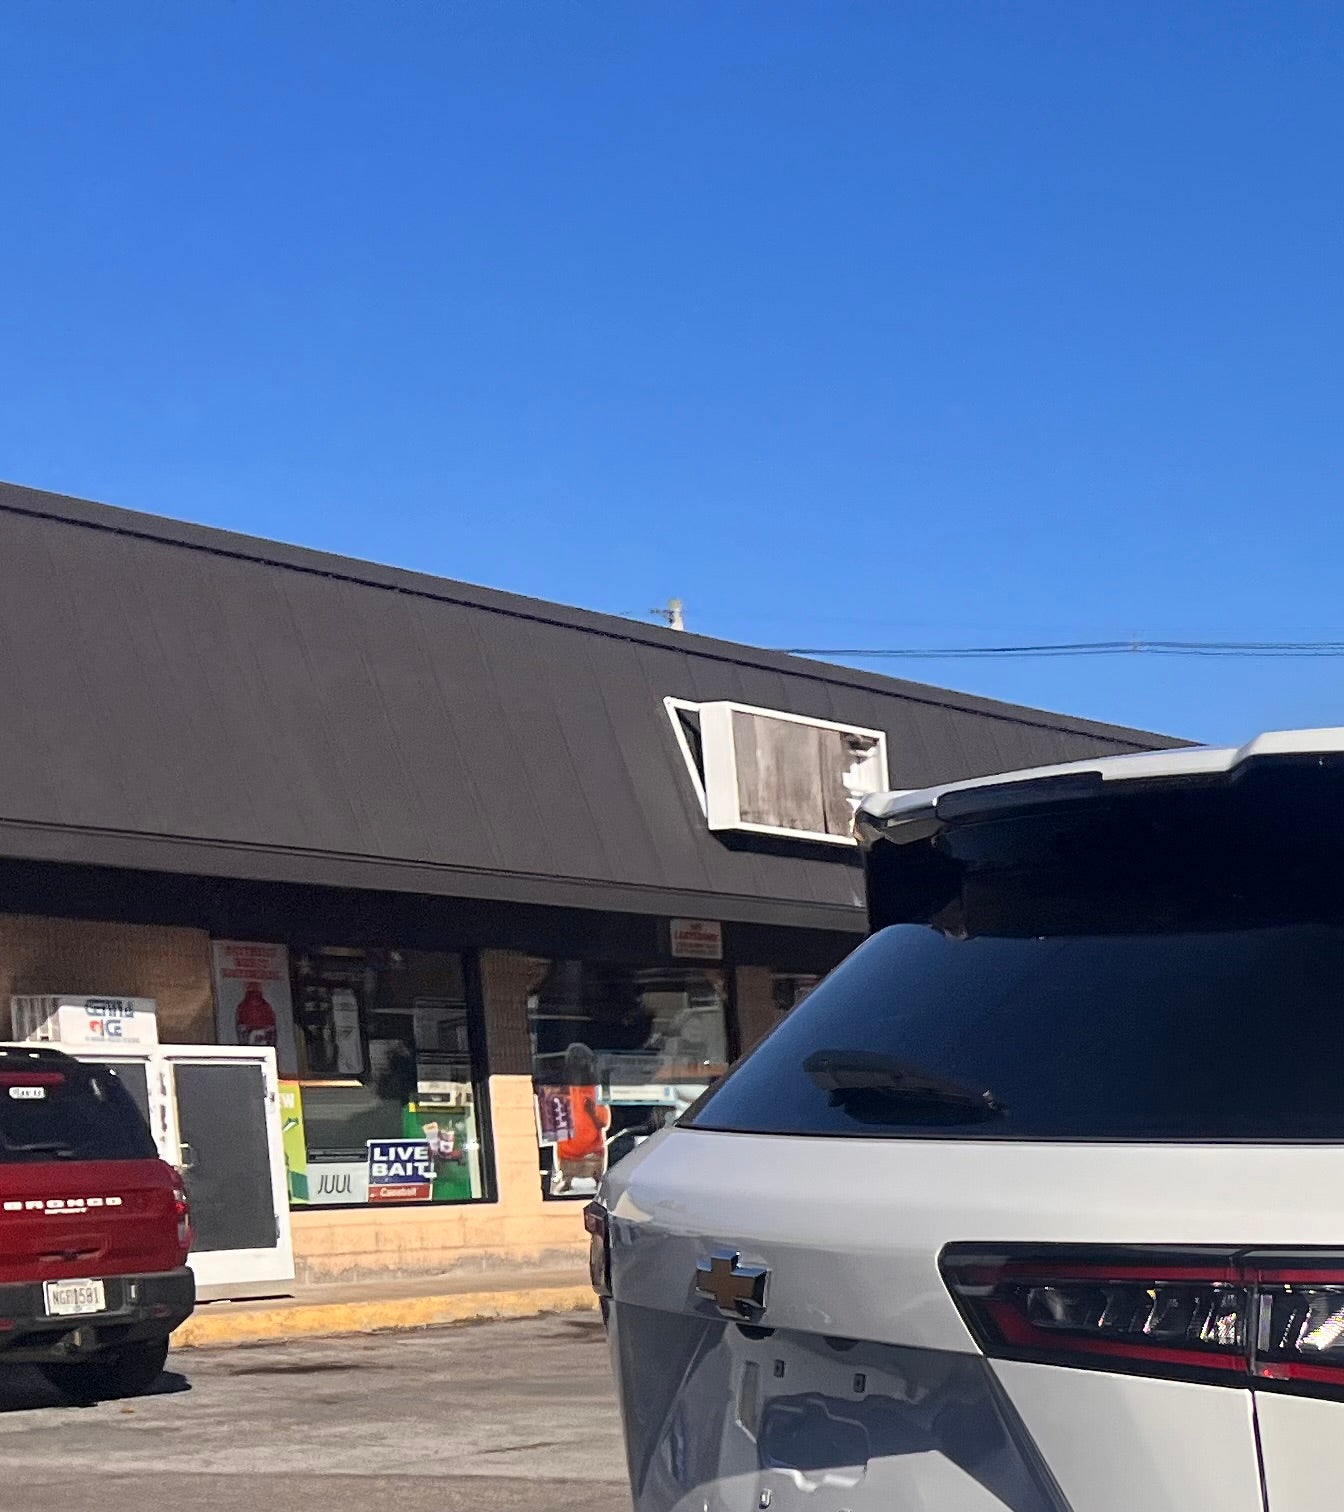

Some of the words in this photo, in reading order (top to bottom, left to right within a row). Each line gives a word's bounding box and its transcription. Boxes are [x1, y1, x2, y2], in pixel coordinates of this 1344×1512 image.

[373, 1146, 429, 1161] LIVE
[371, 1161, 427, 1178] BAIT
[317, 1174, 353, 1195] JUUL
